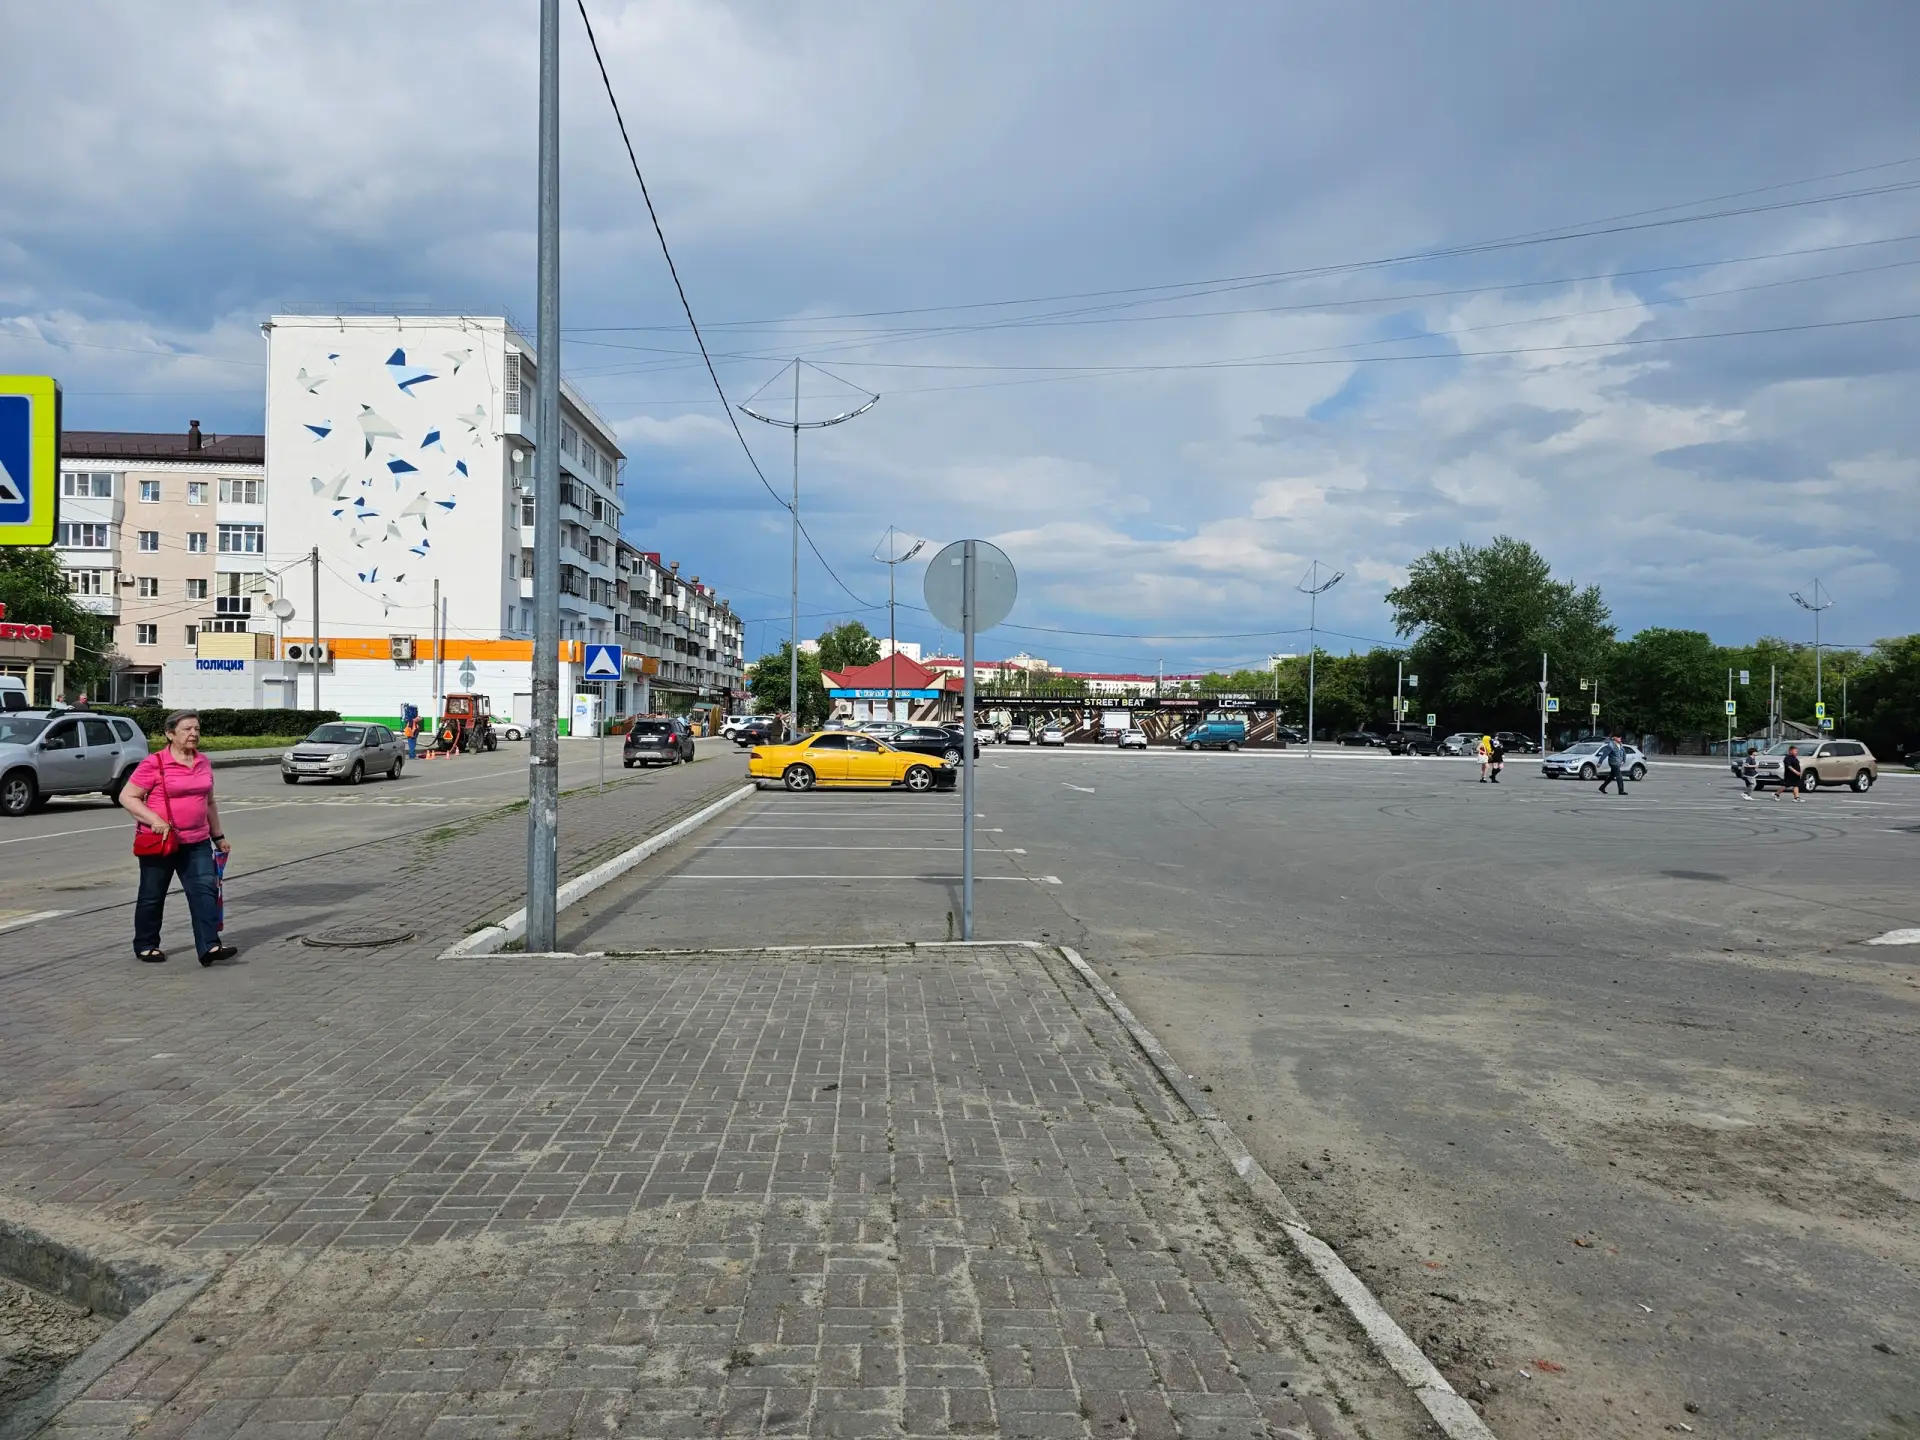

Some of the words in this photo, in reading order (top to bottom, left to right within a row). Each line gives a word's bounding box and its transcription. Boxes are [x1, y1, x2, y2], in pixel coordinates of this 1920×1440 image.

[196, 659, 244, 672] ПОЛИЦИЯ
[1084, 698, 1119, 706] STREET
[1121, 698, 1146, 707] BEAT
